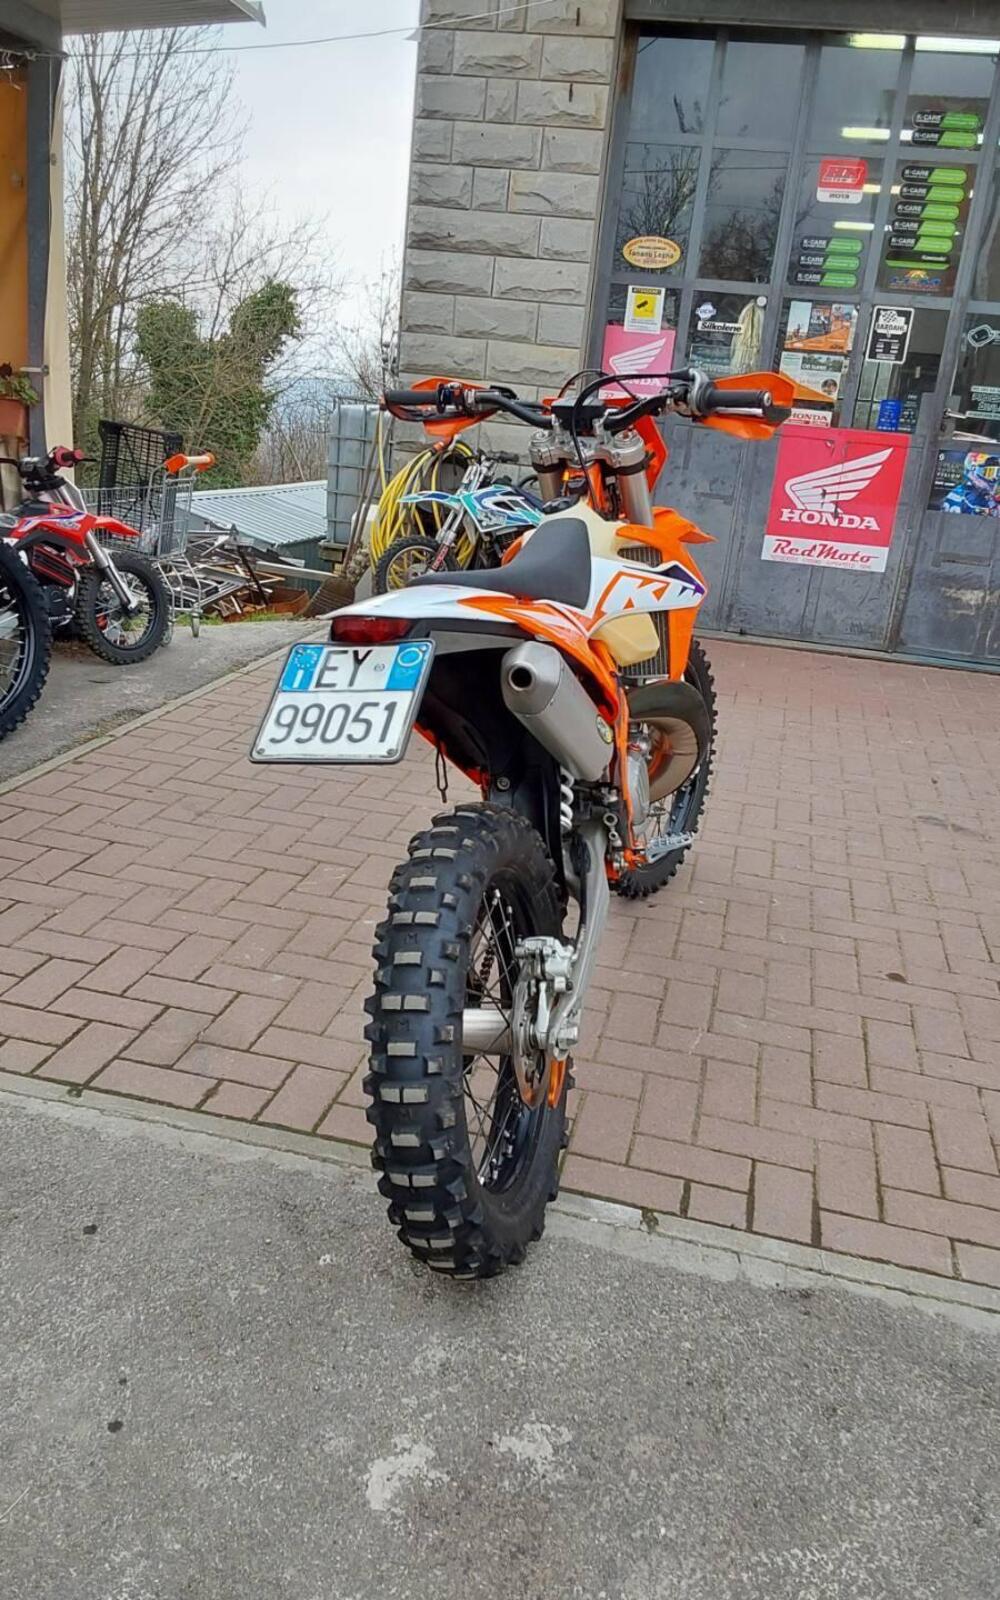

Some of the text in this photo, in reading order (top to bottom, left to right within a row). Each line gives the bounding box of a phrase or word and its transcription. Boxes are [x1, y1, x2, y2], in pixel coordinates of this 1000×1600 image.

[701, 321, 742, 332] Silkolene
[780, 508, 880, 531] HONDA
[772, 539, 880, 563] RedMoto
[315, 650, 373, 688] EY
[269, 701, 397, 744] 99051
